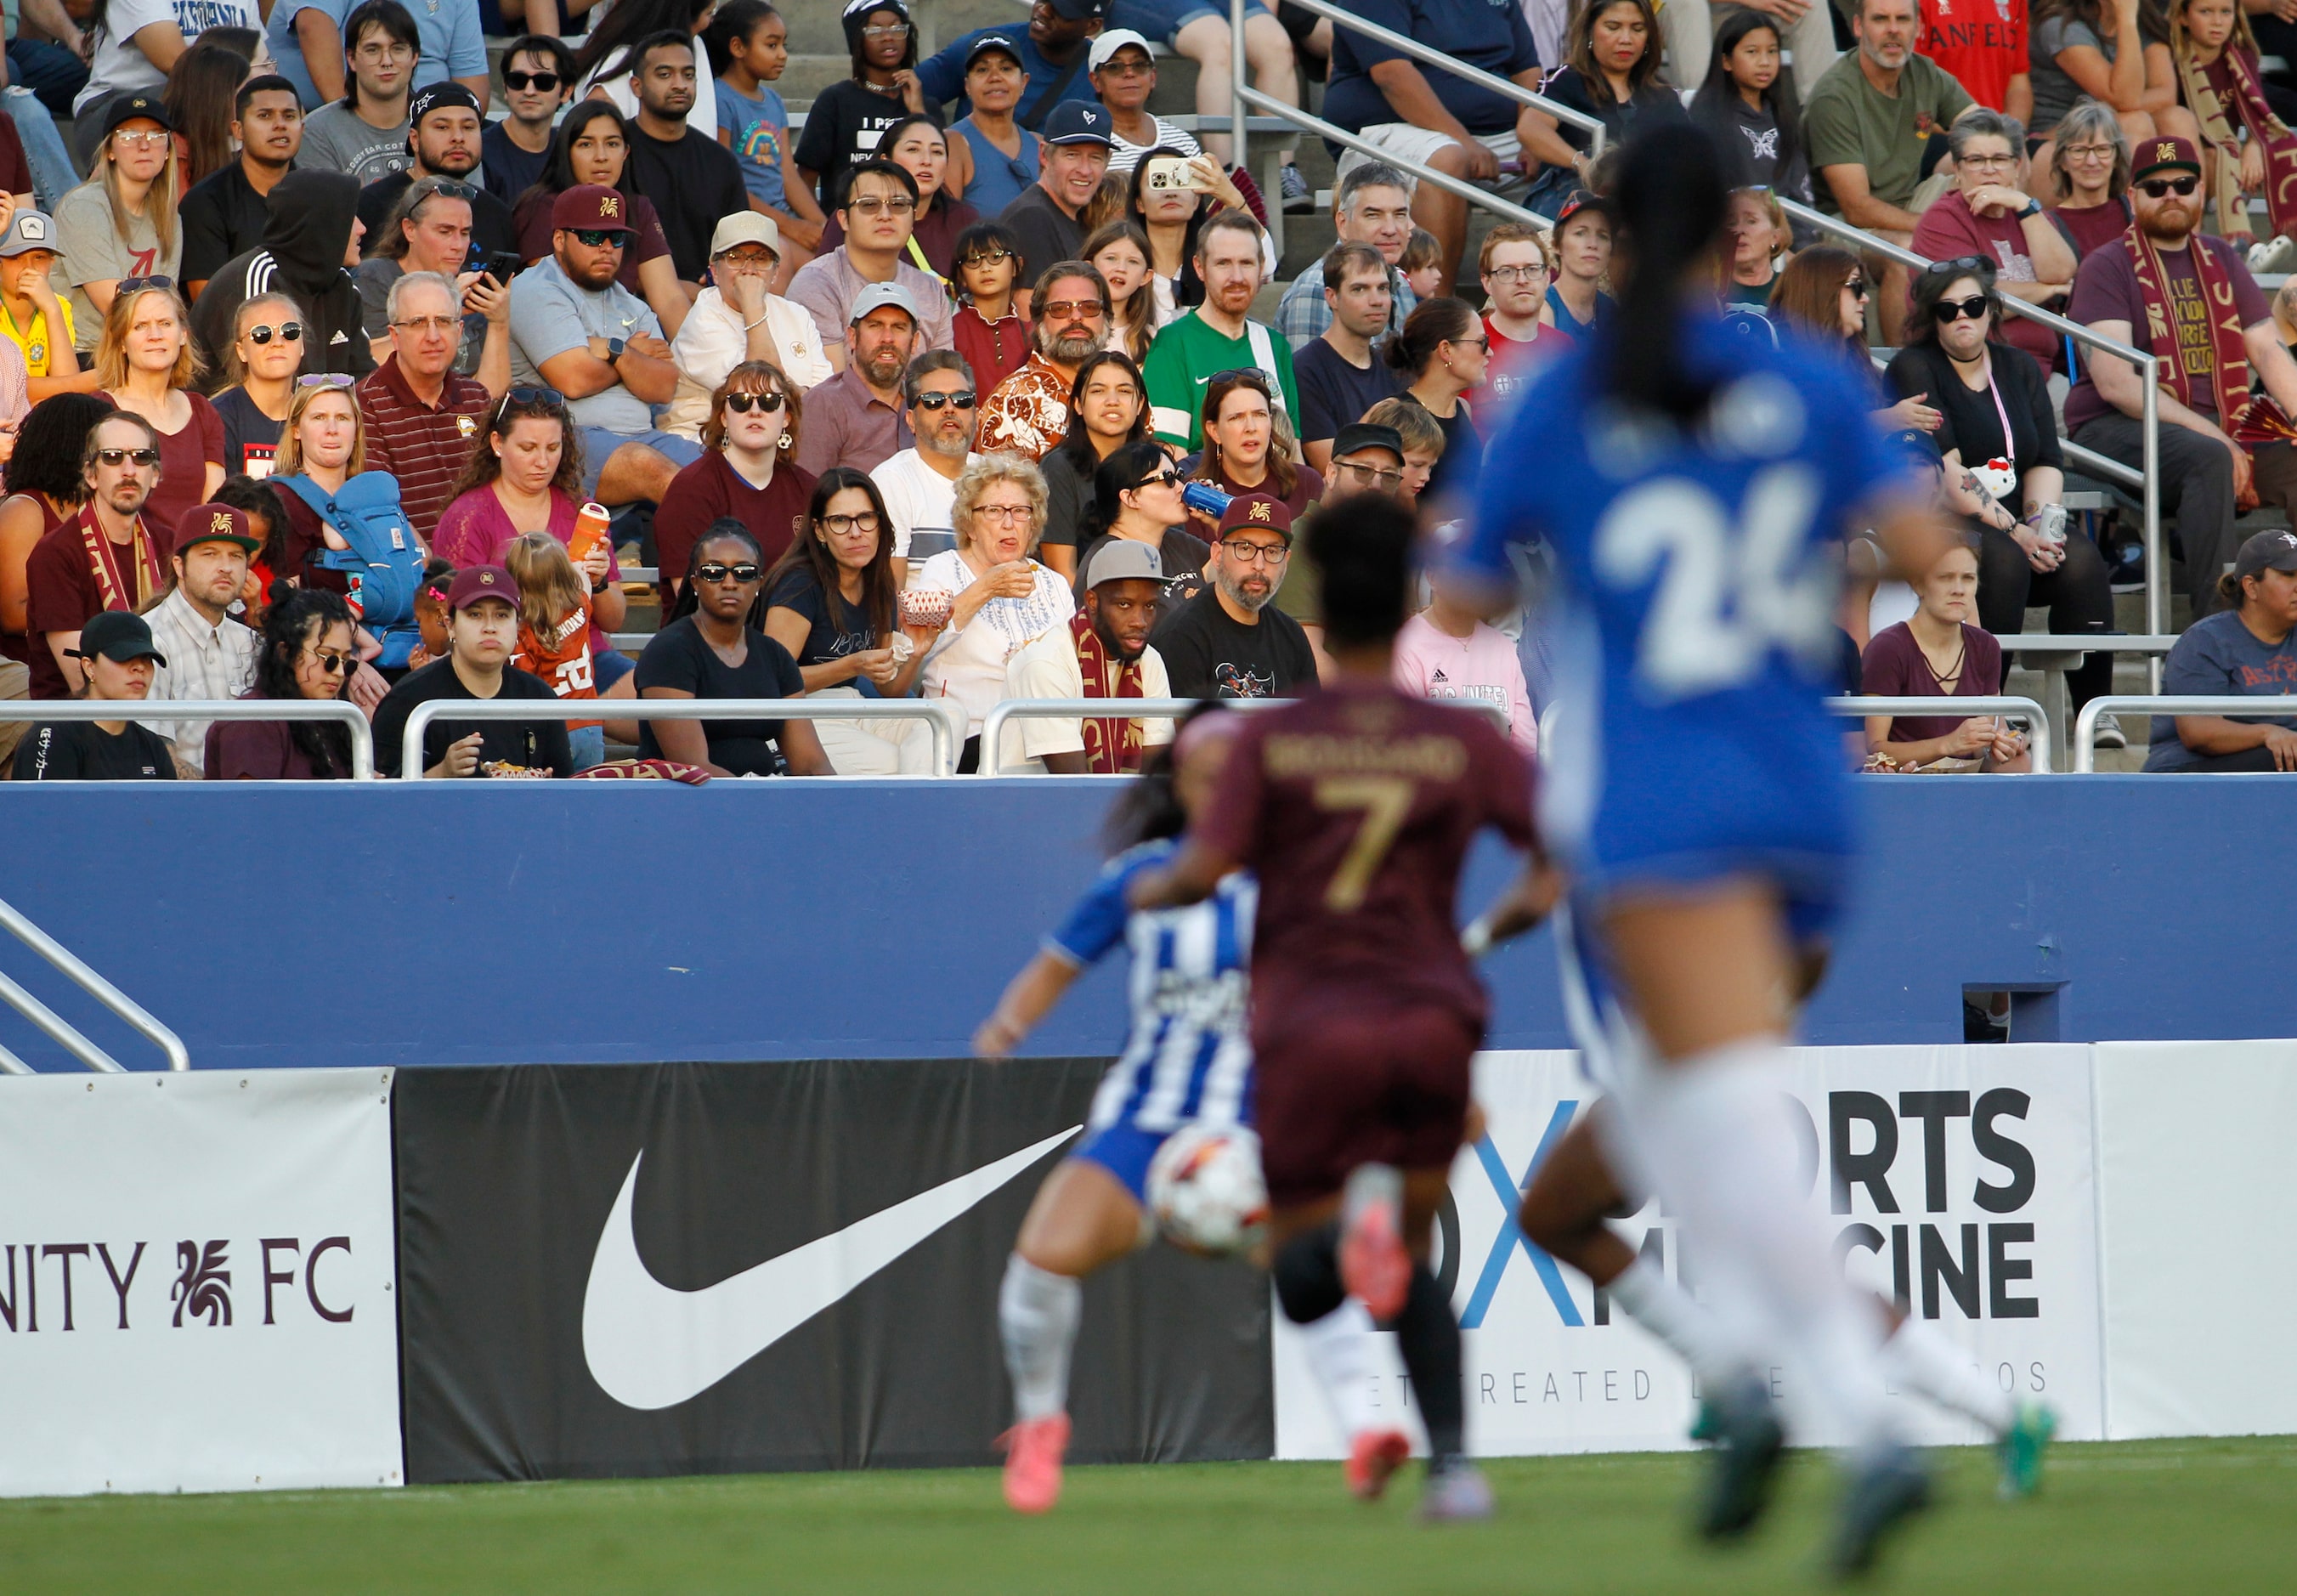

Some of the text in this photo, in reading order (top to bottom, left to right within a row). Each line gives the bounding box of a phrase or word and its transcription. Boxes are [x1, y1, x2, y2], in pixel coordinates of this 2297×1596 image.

[1313, 775, 1417, 909] 7
[259, 1237, 354, 1324] FC
[1480, 1369, 1651, 1405] REATED
